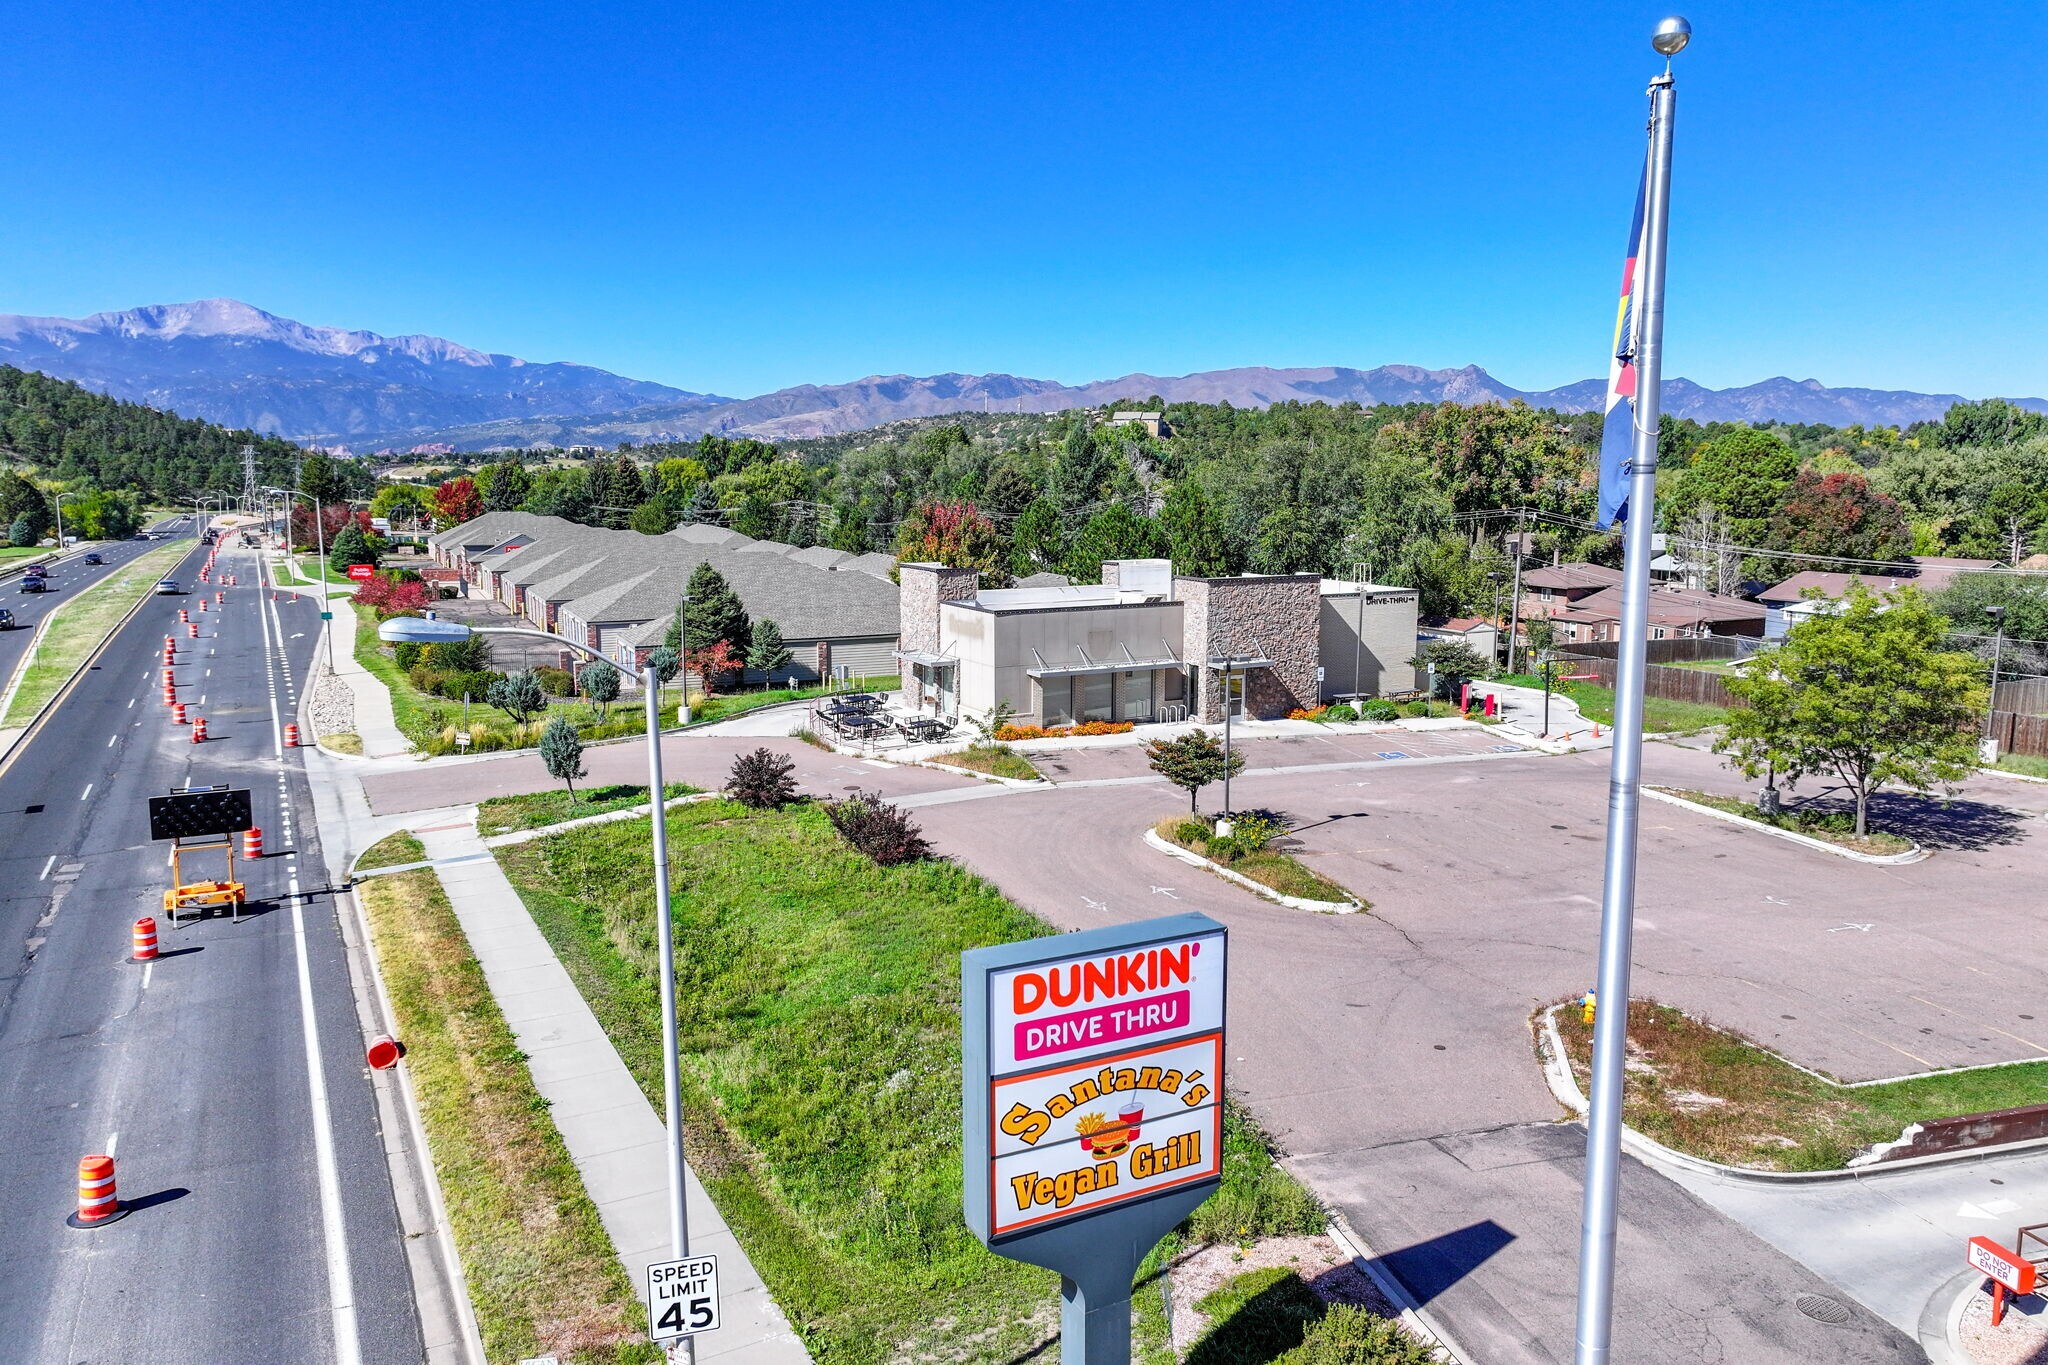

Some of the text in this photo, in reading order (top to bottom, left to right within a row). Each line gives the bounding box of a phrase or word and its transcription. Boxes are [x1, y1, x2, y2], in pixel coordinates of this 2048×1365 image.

[1366, 596, 1408, 605] DRIVE-THRU
[1013, 942, 1200, 1015] DUNKIN'
[1026, 1000, 1177, 1051] DRIVE THRU
[1000, 1066, 1210, 1146] Santana's
[1011, 1130, 1201, 1211] Vegan Grill
[653, 1262, 713, 1283] SPEED
[1976, 1247, 2013, 1274] DO NOT
[1979, 1258, 2008, 1281] ENTER
[659, 1279, 707, 1299] LIMIT
[657, 1297, 713, 1331] 45
